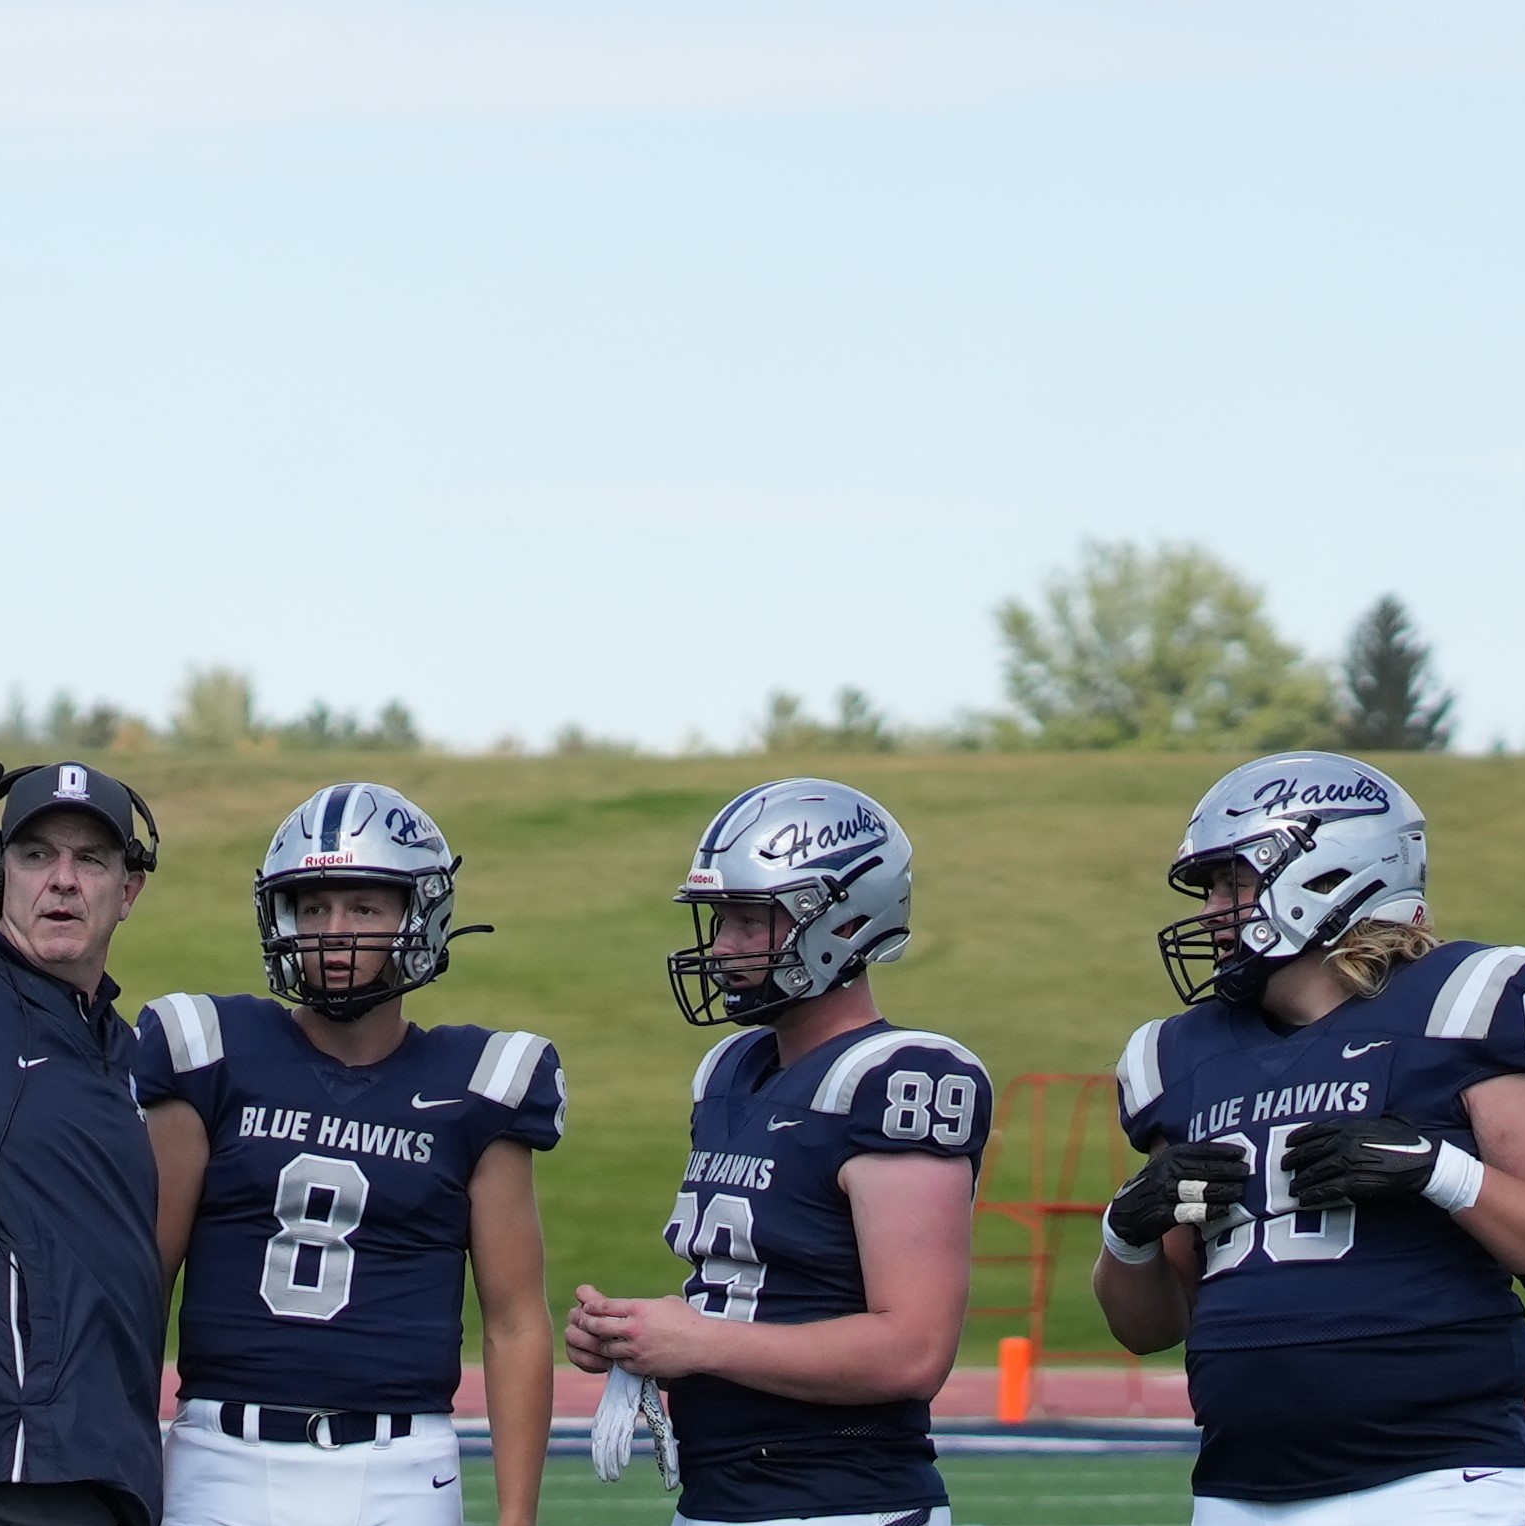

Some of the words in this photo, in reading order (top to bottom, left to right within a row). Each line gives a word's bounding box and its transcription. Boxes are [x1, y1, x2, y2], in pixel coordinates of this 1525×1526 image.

[59, 765, 87, 792] D
[1254, 776, 1389, 815] Hawks
[305, 852, 353, 867] Riddell
[882, 1070, 977, 1146] 89
[1252, 1081, 1370, 1122] HAWKS
[238, 1106, 311, 1142] BLUE
[317, 1115, 435, 1164] HAWKS
[704, 1152, 775, 1190] HAWKS
[259, 1152, 370, 1322] 8
